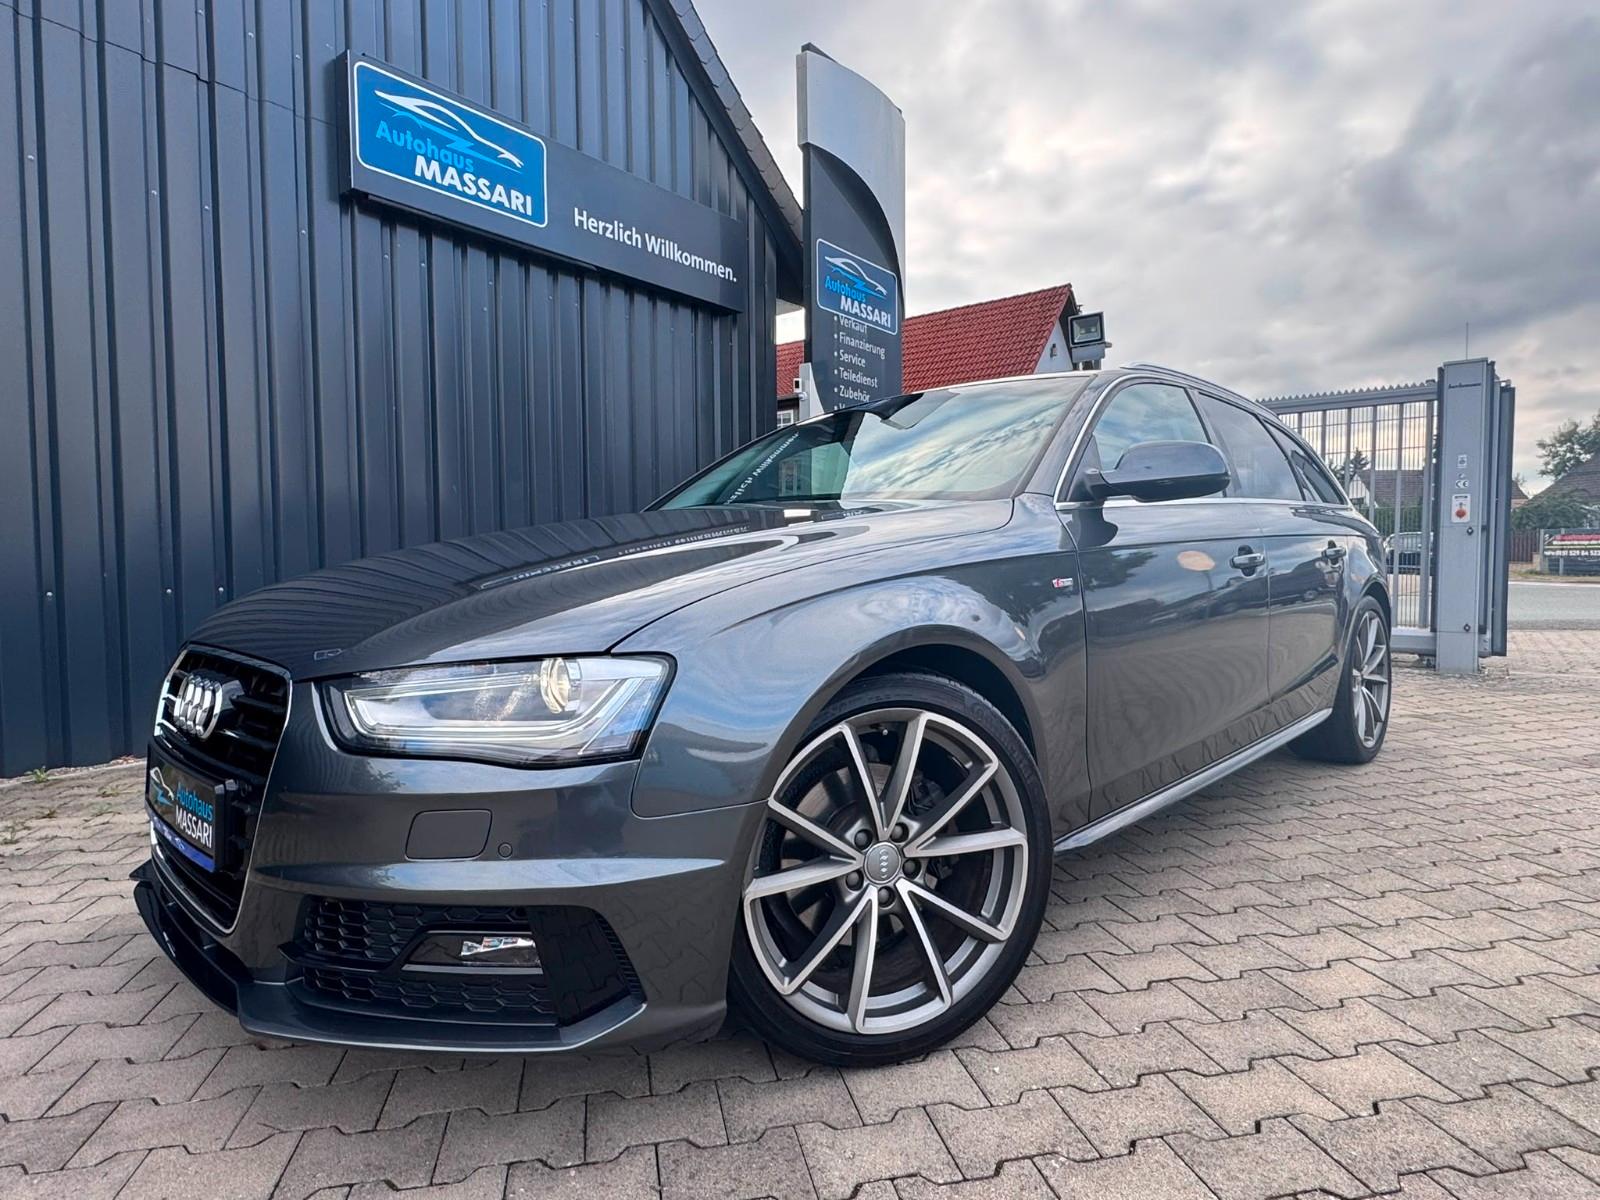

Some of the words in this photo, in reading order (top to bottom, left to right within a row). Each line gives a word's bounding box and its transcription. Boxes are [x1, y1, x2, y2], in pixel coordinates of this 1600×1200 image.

[376, 120, 475, 173] Autohaus
[414, 154, 533, 217] MASSARI
[574, 207, 642, 249] Herzlich
[645, 232, 737, 282] Willkommen.
[825, 275, 866, 303] Autohaus
[839, 314, 868, 334] Verkauf
[840, 295, 891, 328] MASSARI
[839, 333, 886, 360] Finanzierung
[839, 350, 866, 368] Service
[839, 368, 878, 388] Teiledienst
[839, 386, 870, 402] Zubehör
[176, 781, 213, 821] Autohaus
[175, 805, 212, 848] MASSARI
